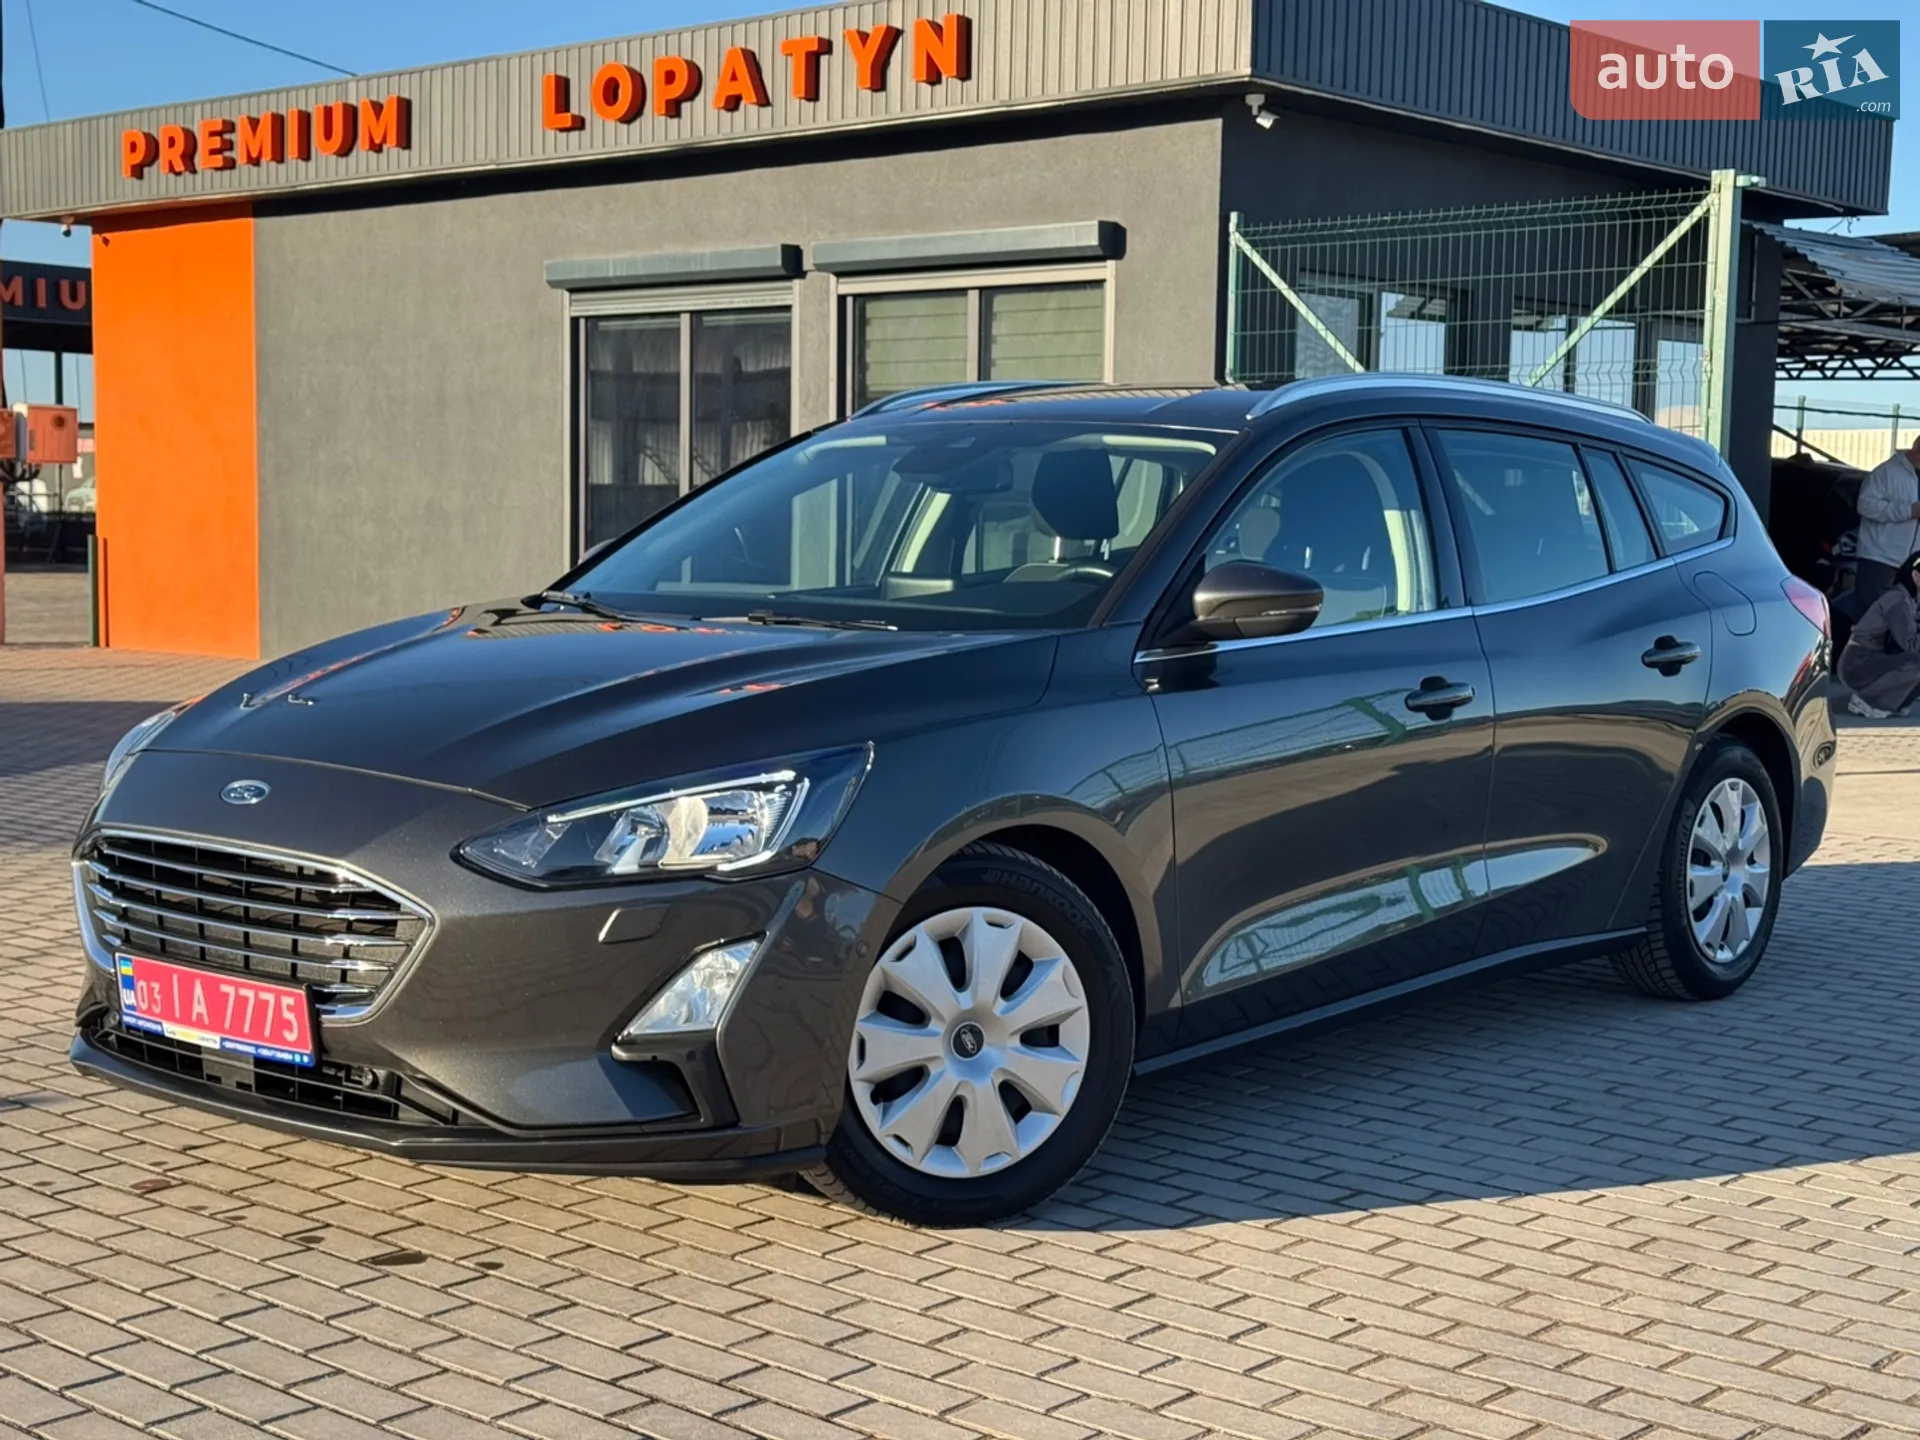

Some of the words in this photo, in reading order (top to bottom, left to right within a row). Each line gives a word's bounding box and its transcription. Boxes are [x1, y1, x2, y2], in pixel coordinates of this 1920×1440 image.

[122, 94, 411, 179] PREMIUM
[543, 13, 972, 132] LOPATYN
[122, 987, 137, 1007] UA
[136, 980, 162, 1015] 03
[219, 983, 299, 1043] 7775
